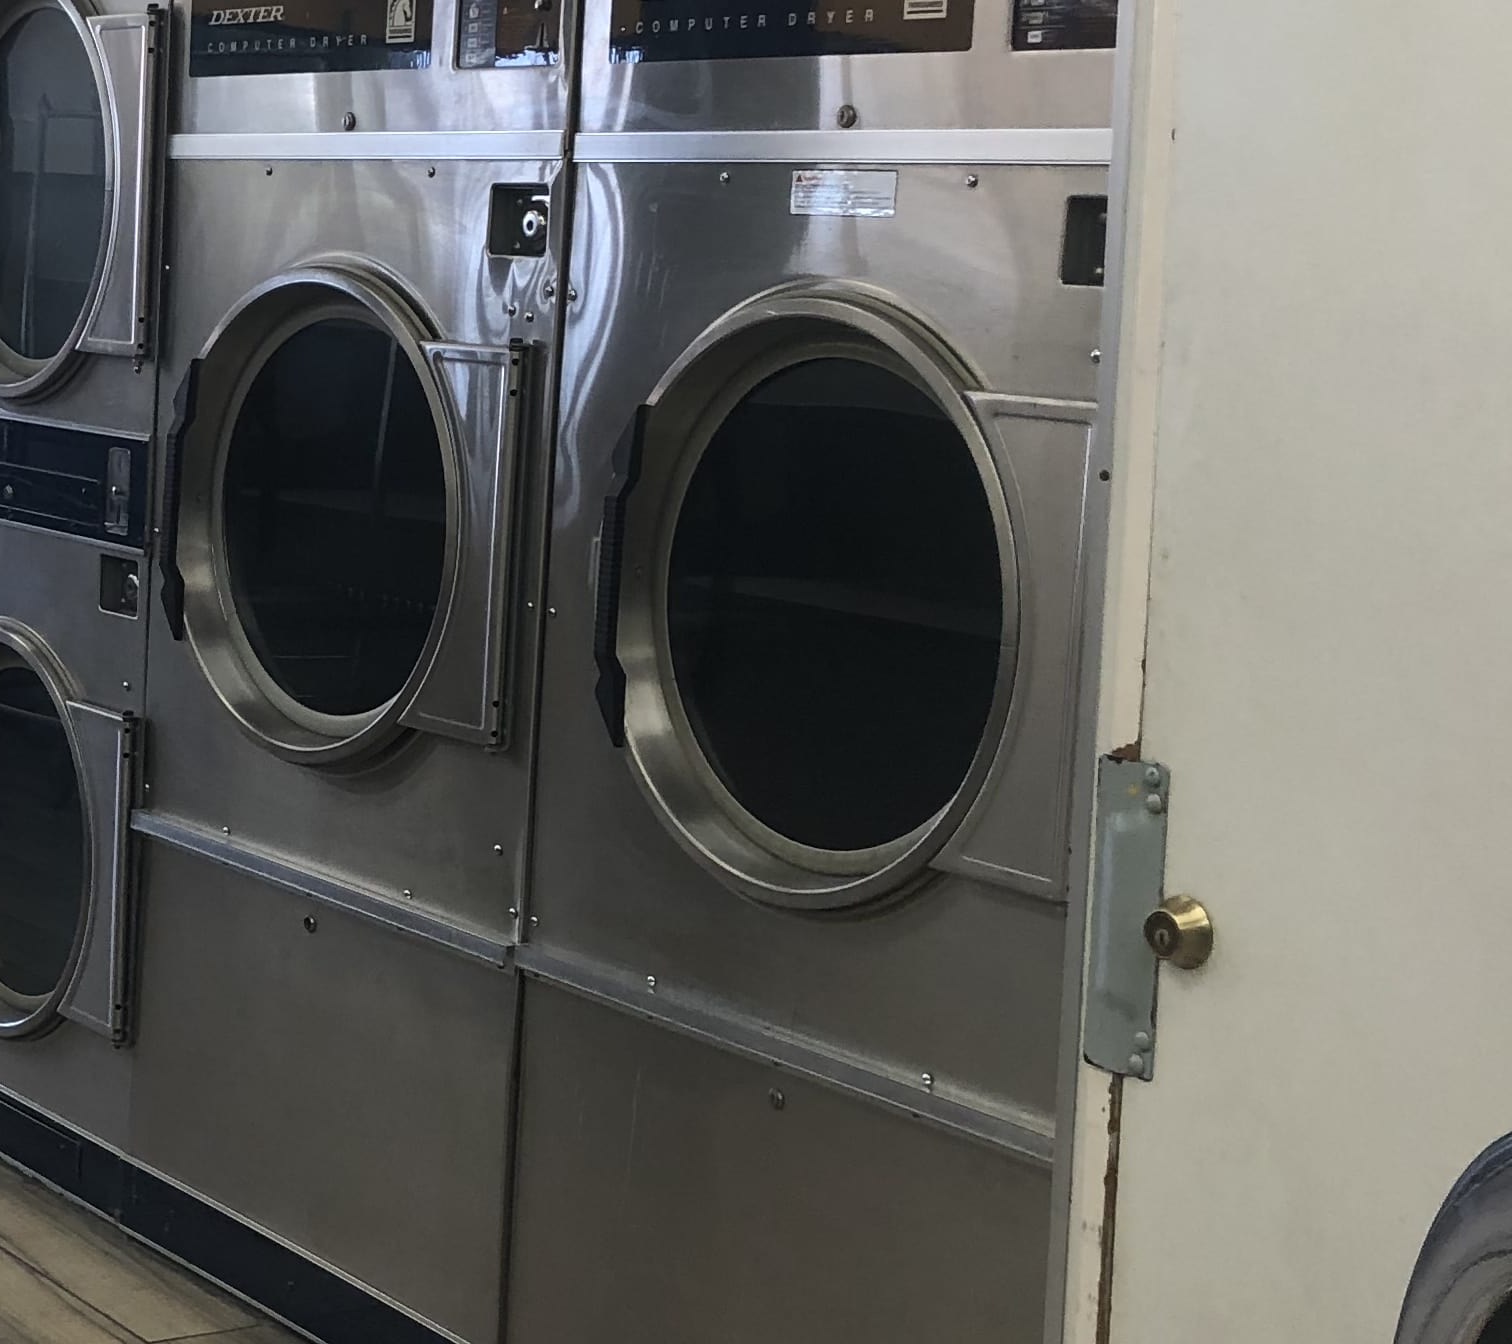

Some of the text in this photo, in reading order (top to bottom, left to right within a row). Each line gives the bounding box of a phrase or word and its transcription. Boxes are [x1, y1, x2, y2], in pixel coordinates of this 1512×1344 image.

[208, 5, 286, 26] DEXTER
[635, 8, 875, 35] COMPUTER DRYER
[207, 33, 368, 54] COMPUTER DRYER
